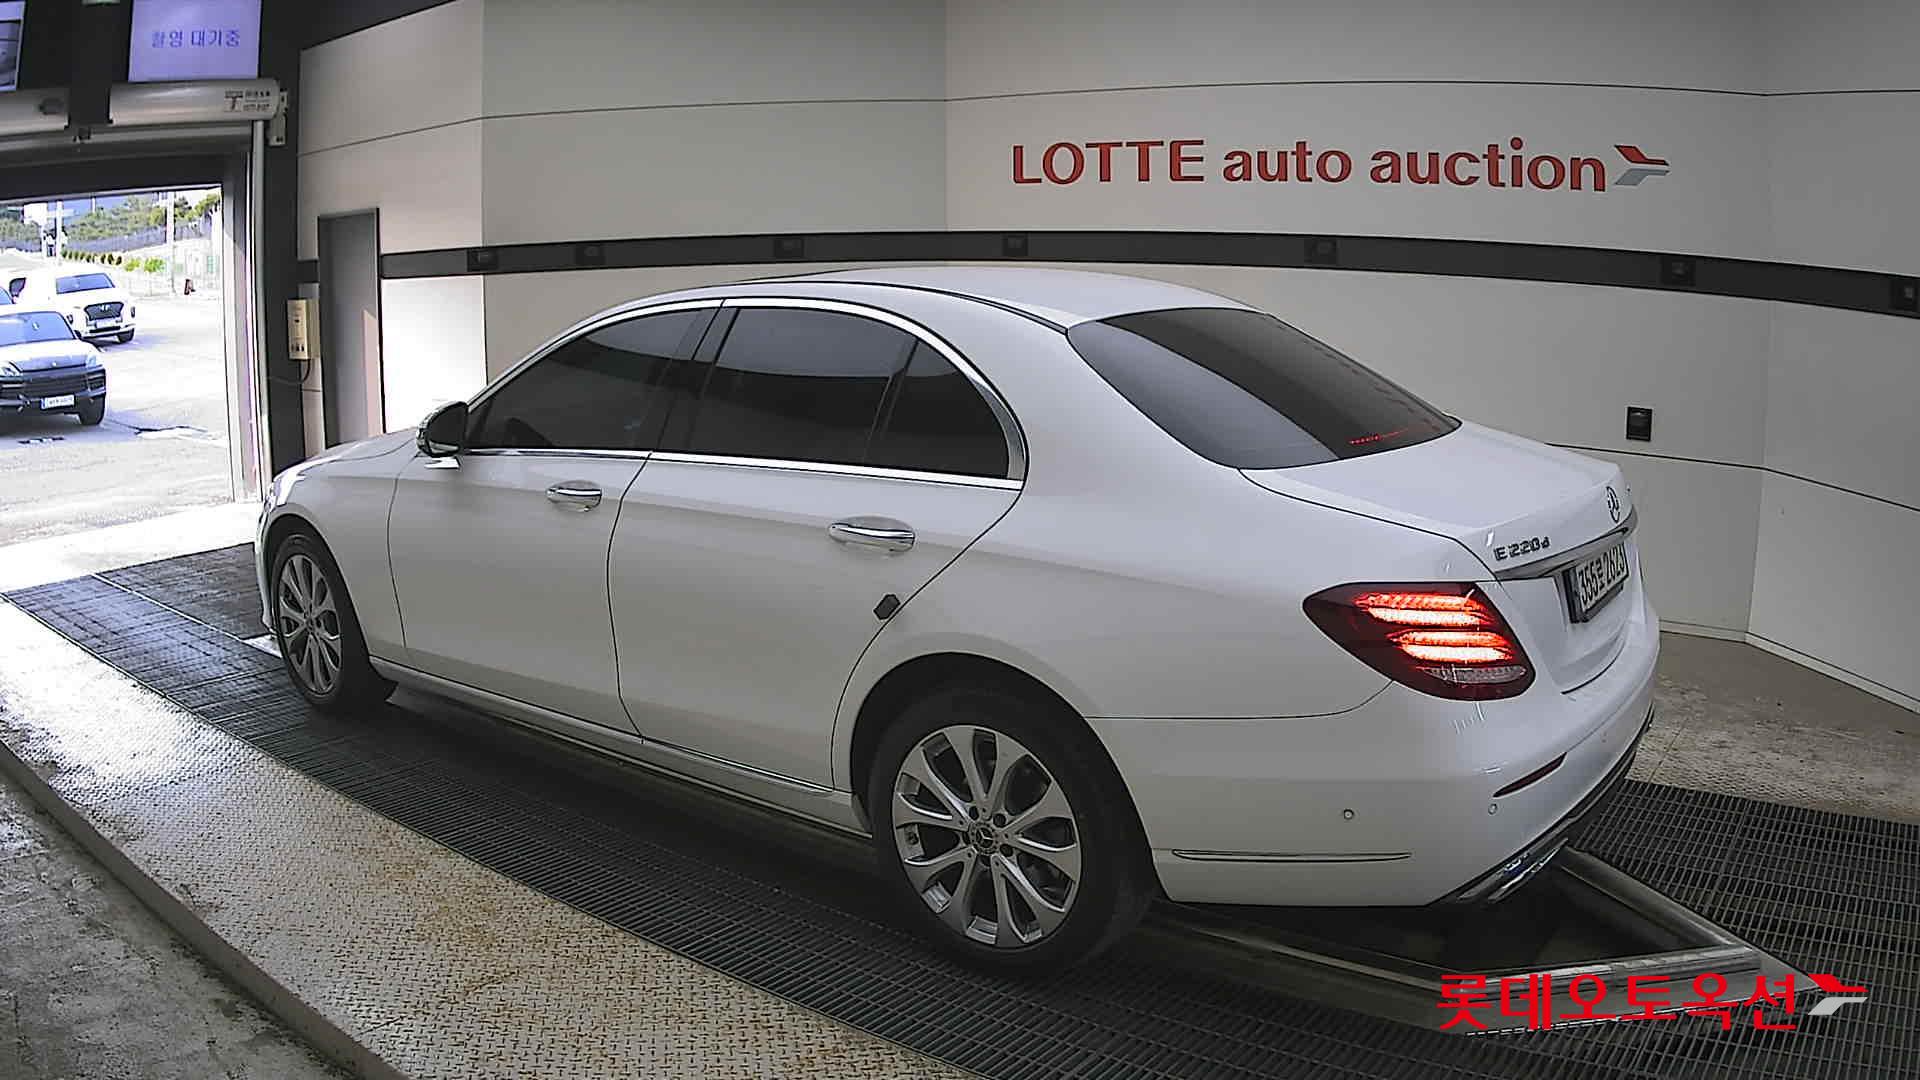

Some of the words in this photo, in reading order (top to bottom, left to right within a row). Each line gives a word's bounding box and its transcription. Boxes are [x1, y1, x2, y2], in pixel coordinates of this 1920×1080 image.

[191, 28, 240, 48] 대기중
[1012, 140, 1205, 184] LOTTE
[1223, 141, 1352, 183] auto
[1370, 137, 1606, 192] auction
